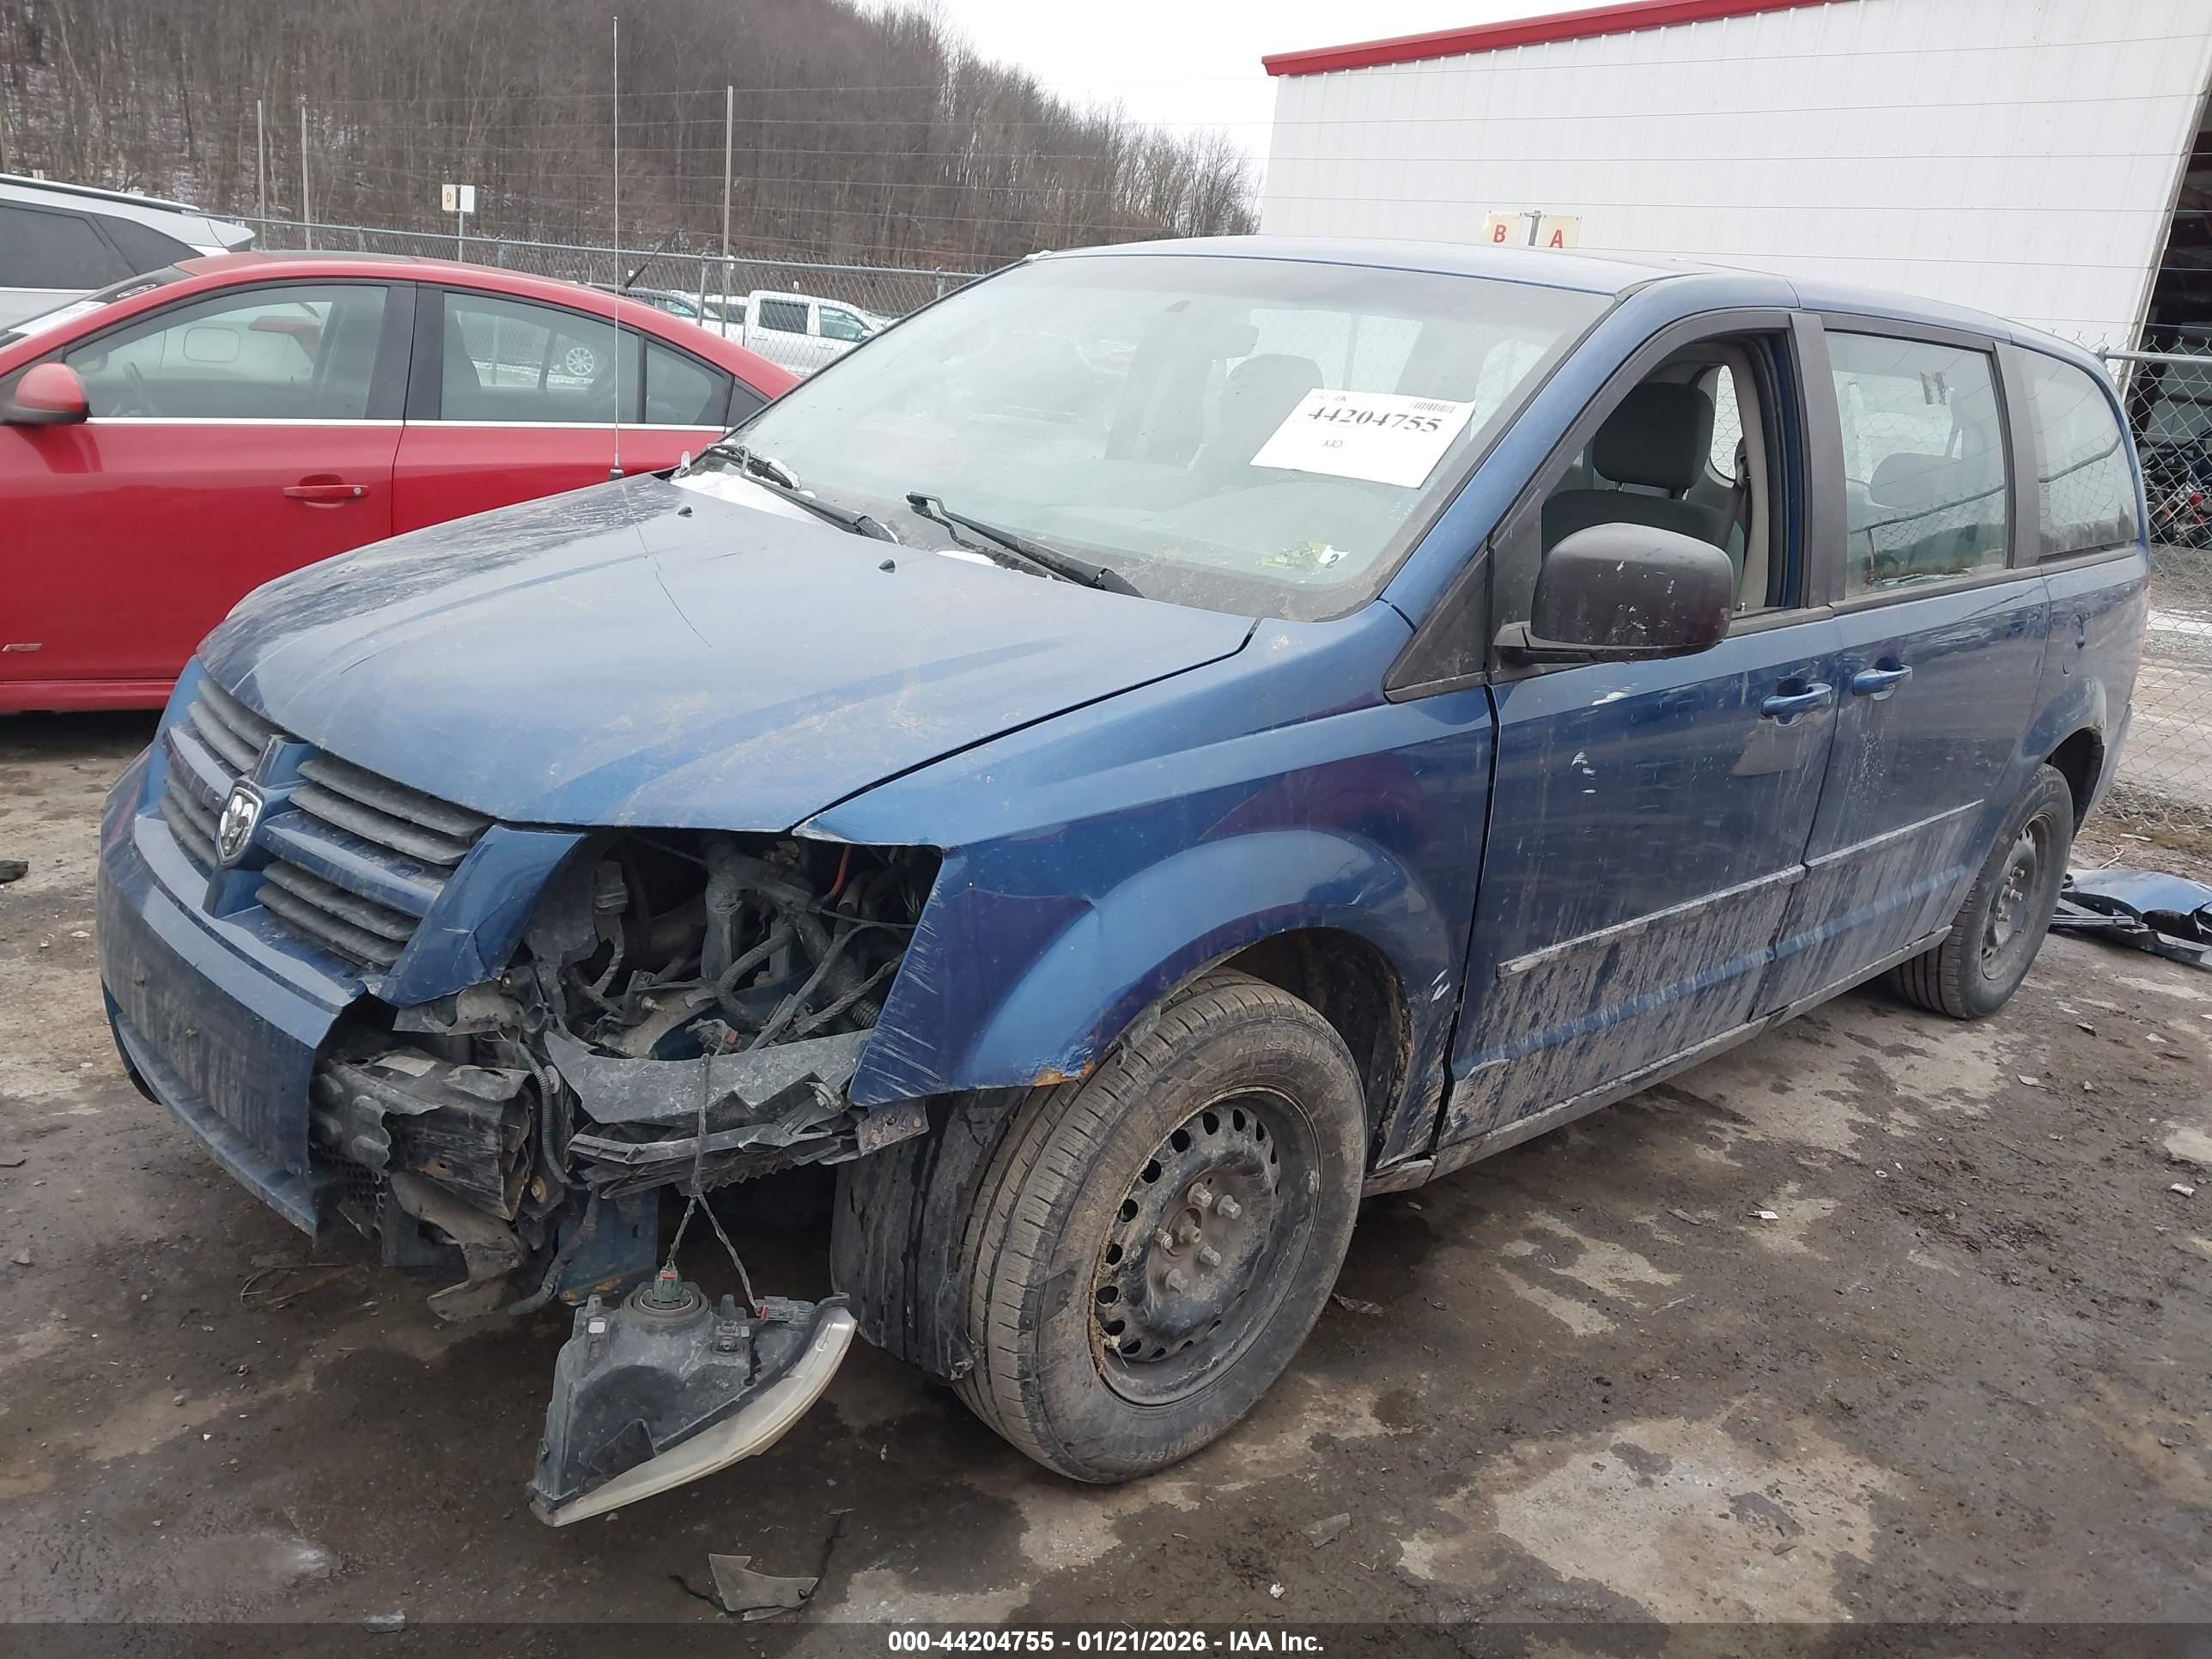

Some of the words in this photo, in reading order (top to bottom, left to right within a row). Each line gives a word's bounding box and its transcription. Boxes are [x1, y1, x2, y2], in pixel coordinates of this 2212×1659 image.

[1492, 224, 1507, 243] B
[1549, 229, 1564, 248] A
[1307, 406, 1443, 433] 44204755
[1325, 553, 1340, 570] 2
